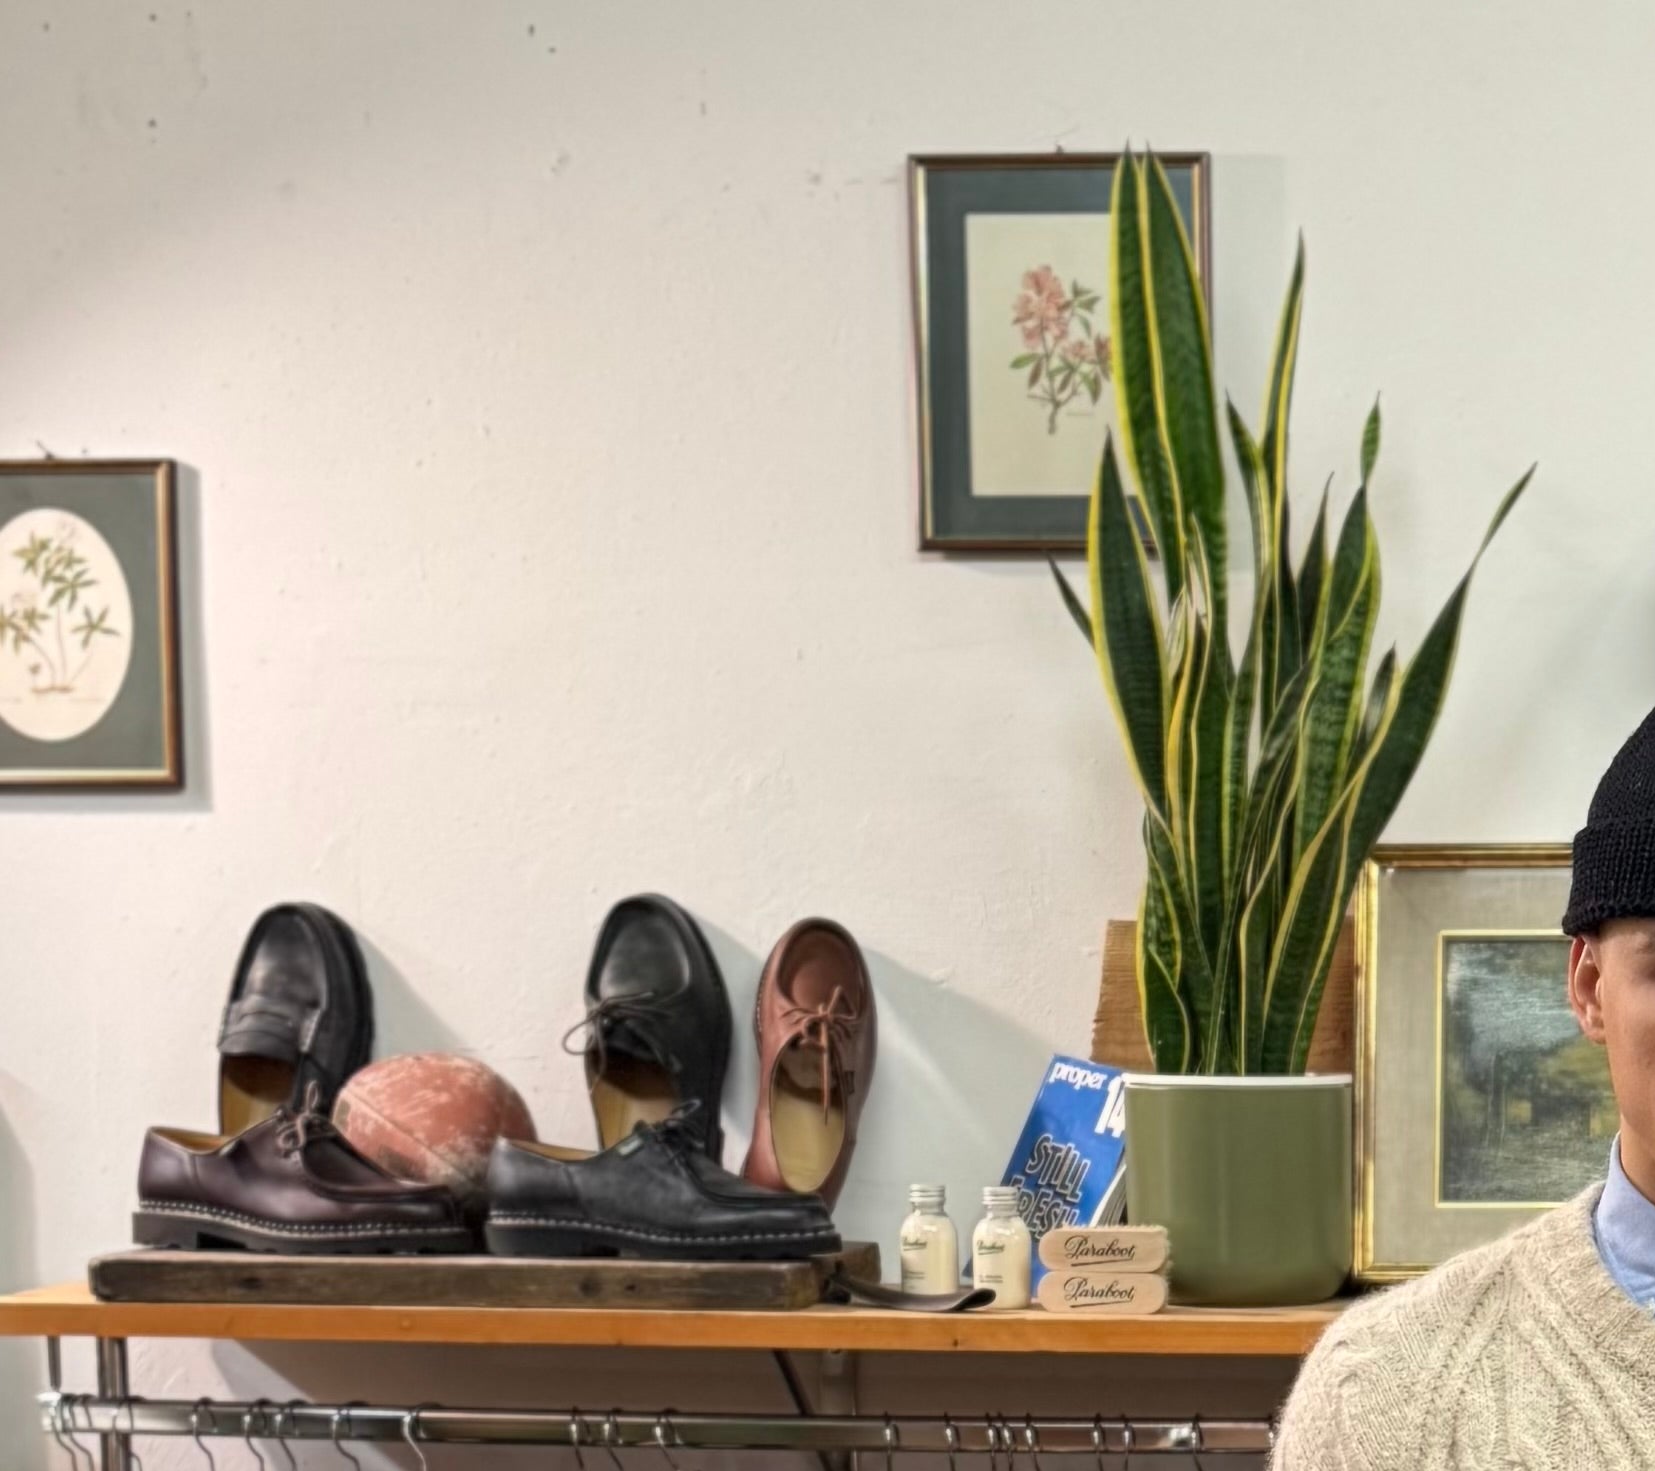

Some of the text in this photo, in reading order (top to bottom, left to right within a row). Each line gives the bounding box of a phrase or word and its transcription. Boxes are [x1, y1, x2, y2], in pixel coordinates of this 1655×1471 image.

[1049, 1062, 1108, 1091] proper
[1025, 1133, 1092, 1203] STILL
[1063, 1235, 1136, 1262] Paraboot
[1063, 1276, 1136, 1303] Paraboot
